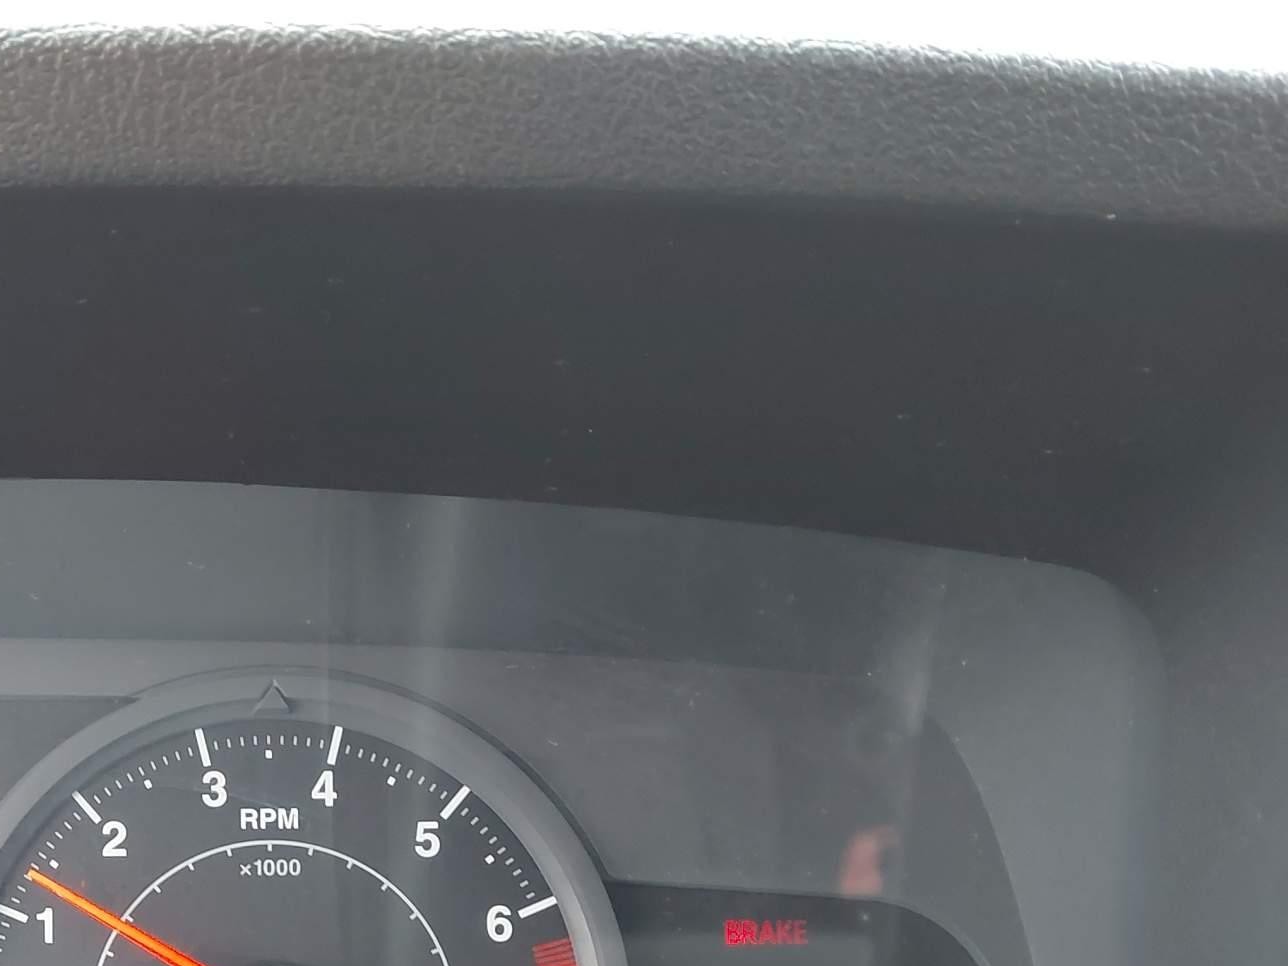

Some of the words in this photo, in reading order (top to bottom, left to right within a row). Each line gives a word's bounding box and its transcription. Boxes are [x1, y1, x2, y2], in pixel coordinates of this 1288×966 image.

[200, 770, 228, 807] 3
[310, 770, 338, 807] 4
[239, 807, 300, 831] RPM
[101, 821, 128, 858] 2
[414, 821, 442, 858] 5
[35, 907, 55, 944] 1
[485, 904, 514, 943] 6
[724, 920, 809, 946] BRAKE
